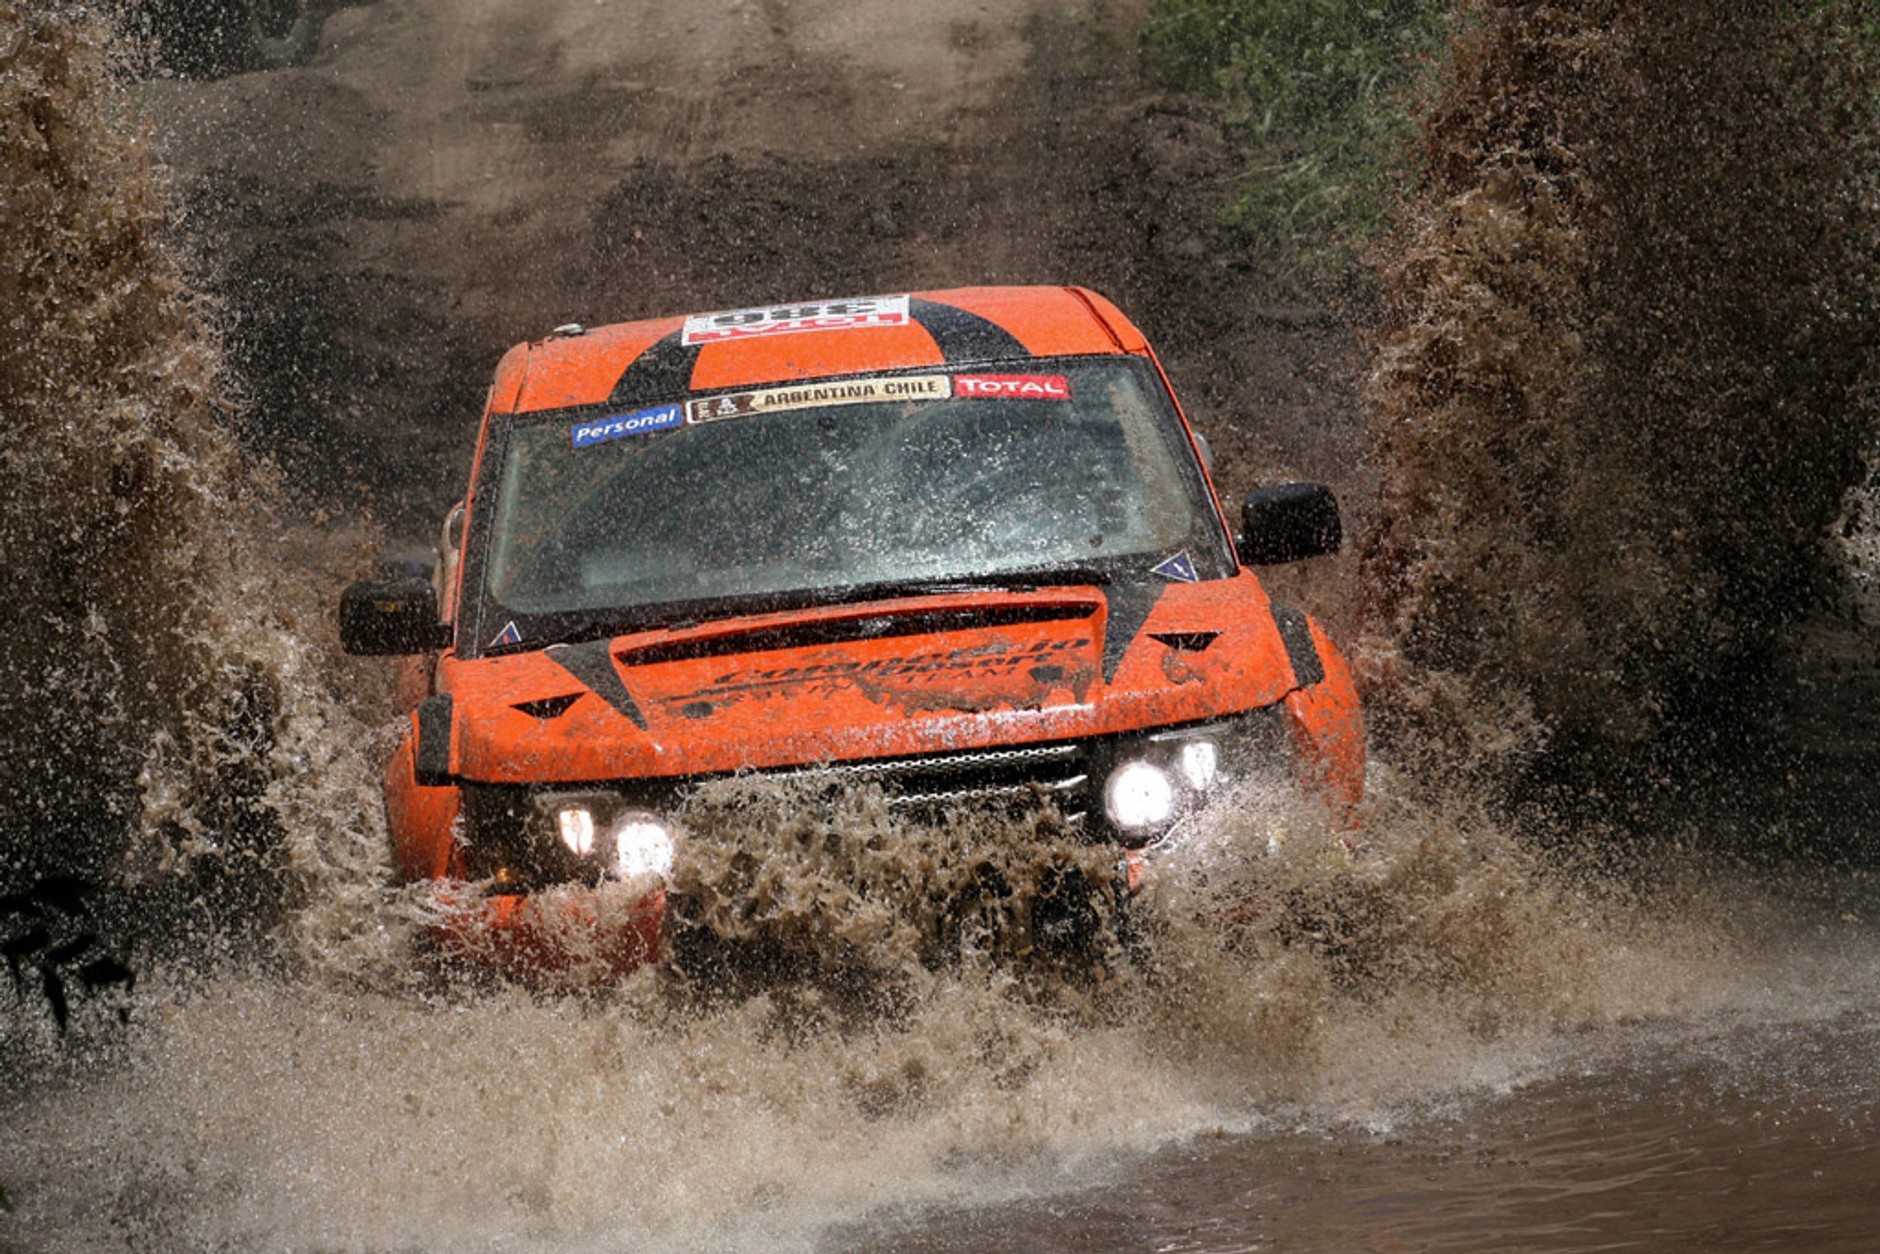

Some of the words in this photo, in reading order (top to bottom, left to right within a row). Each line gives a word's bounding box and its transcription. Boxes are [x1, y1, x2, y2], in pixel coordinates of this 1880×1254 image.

[885, 378, 938, 395] CHILE
[958, 378, 1065, 394] TOTAL
[576, 408, 676, 442] Personal
